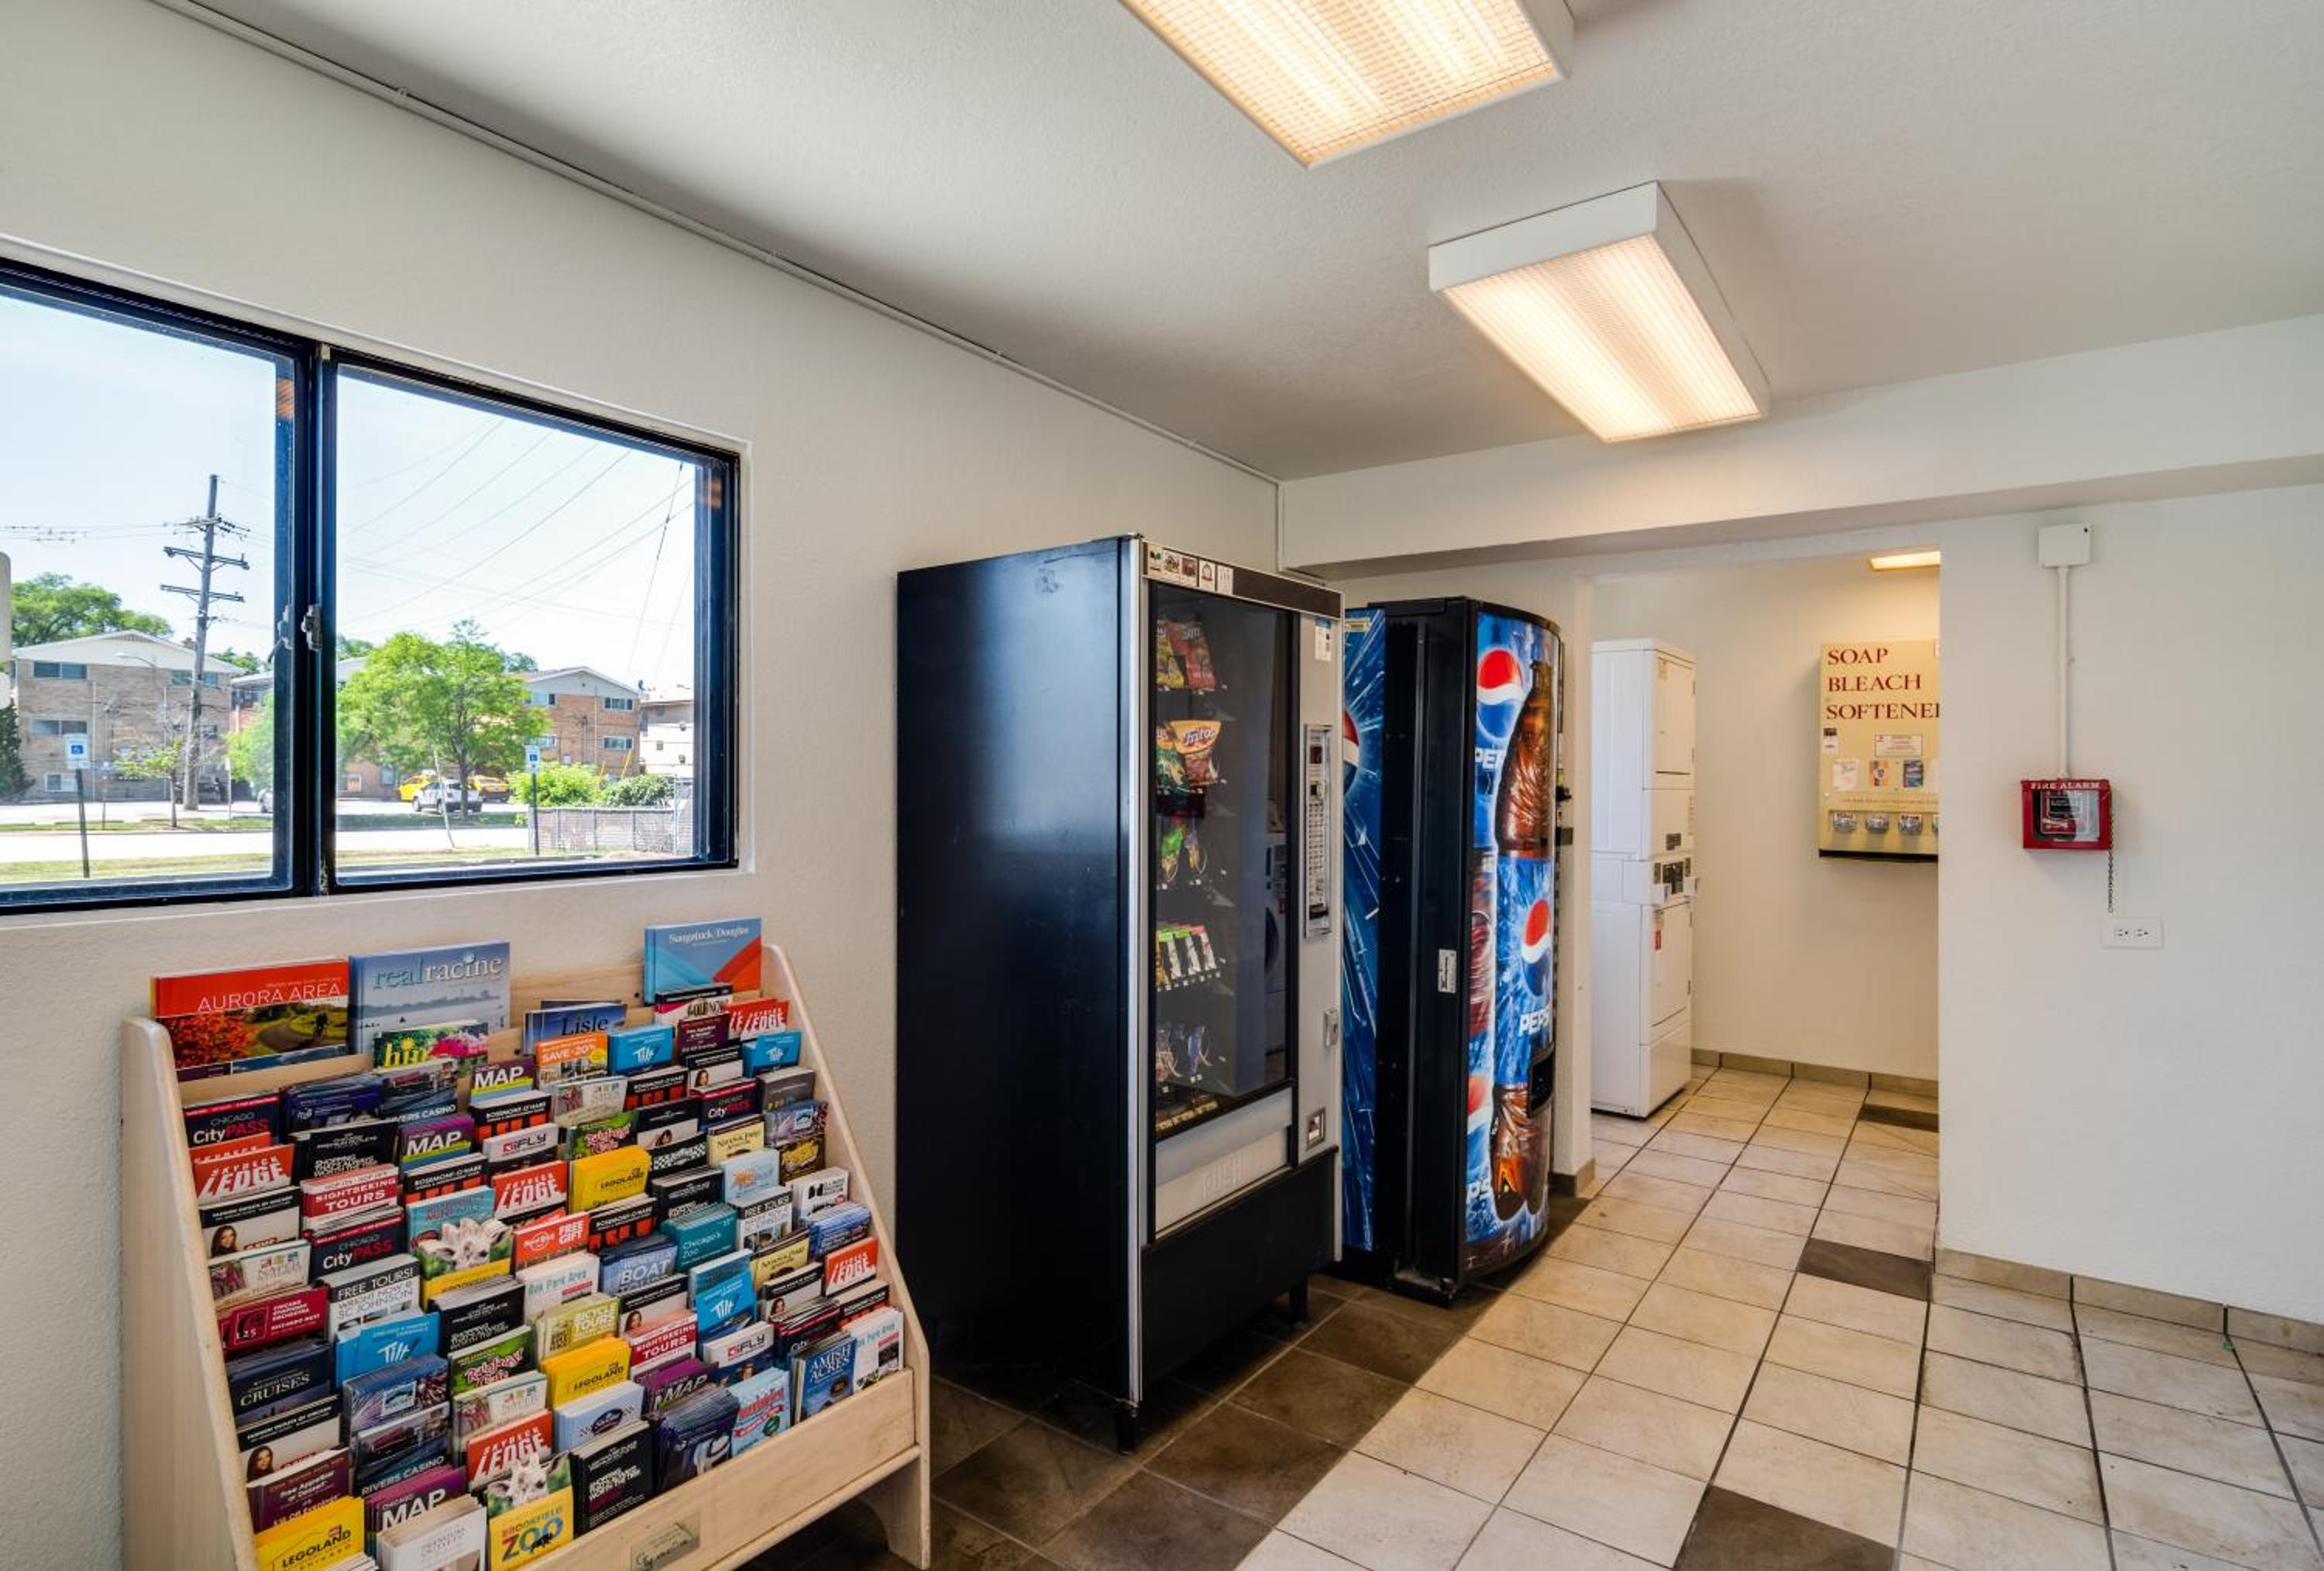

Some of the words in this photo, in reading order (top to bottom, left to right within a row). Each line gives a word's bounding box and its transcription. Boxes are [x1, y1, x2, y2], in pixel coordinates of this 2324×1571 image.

[1827, 648, 1888, 665] SOAP
[1828, 673, 1921, 692] BLEACH
[373, 955, 422, 989] real
[426, 952, 502, 982] racine
[198, 988, 284, 1012] AURORA
[289, 983, 341, 1002] AREA
[560, 1015, 608, 1036] Lisle
[474, 1066, 525, 1089] MAP
[210, 1112, 255, 1126] CHICAGO
[421, 1105, 457, 1120] CASINO
[194, 1119, 270, 1144] CityPASS
[407, 1130, 462, 1157] MAP
[199, 1164, 287, 1201] LEDGE
[315, 1177, 397, 1203] SIGHTSEEING
[325, 1189, 386, 1212] TOURS
[494, 1179, 559, 1219] LEDGE
[559, 1220, 583, 1236] FREE
[559, 1229, 583, 1245] GIFT
[322, 1240, 393, 1269] CityPASS
[621, 1259, 671, 1284] BOAT
[338, 1282, 367, 1301] FREE
[377, 1342, 410, 1363] Tilt
[643, 1335, 688, 1360] TOURS
[240, 1373, 311, 1406] CRUISES
[573, 1365, 624, 1390] LEGOLAND
[665, 1373, 708, 1402] MAP
[362, 1473, 401, 1496] RIVERS
[402, 1455, 445, 1477] CASINO
[382, 1487, 447, 1531] MAP
[282, 1530, 352, 1568] LEGOLAND
[502, 1516, 564, 1562] ZOO
